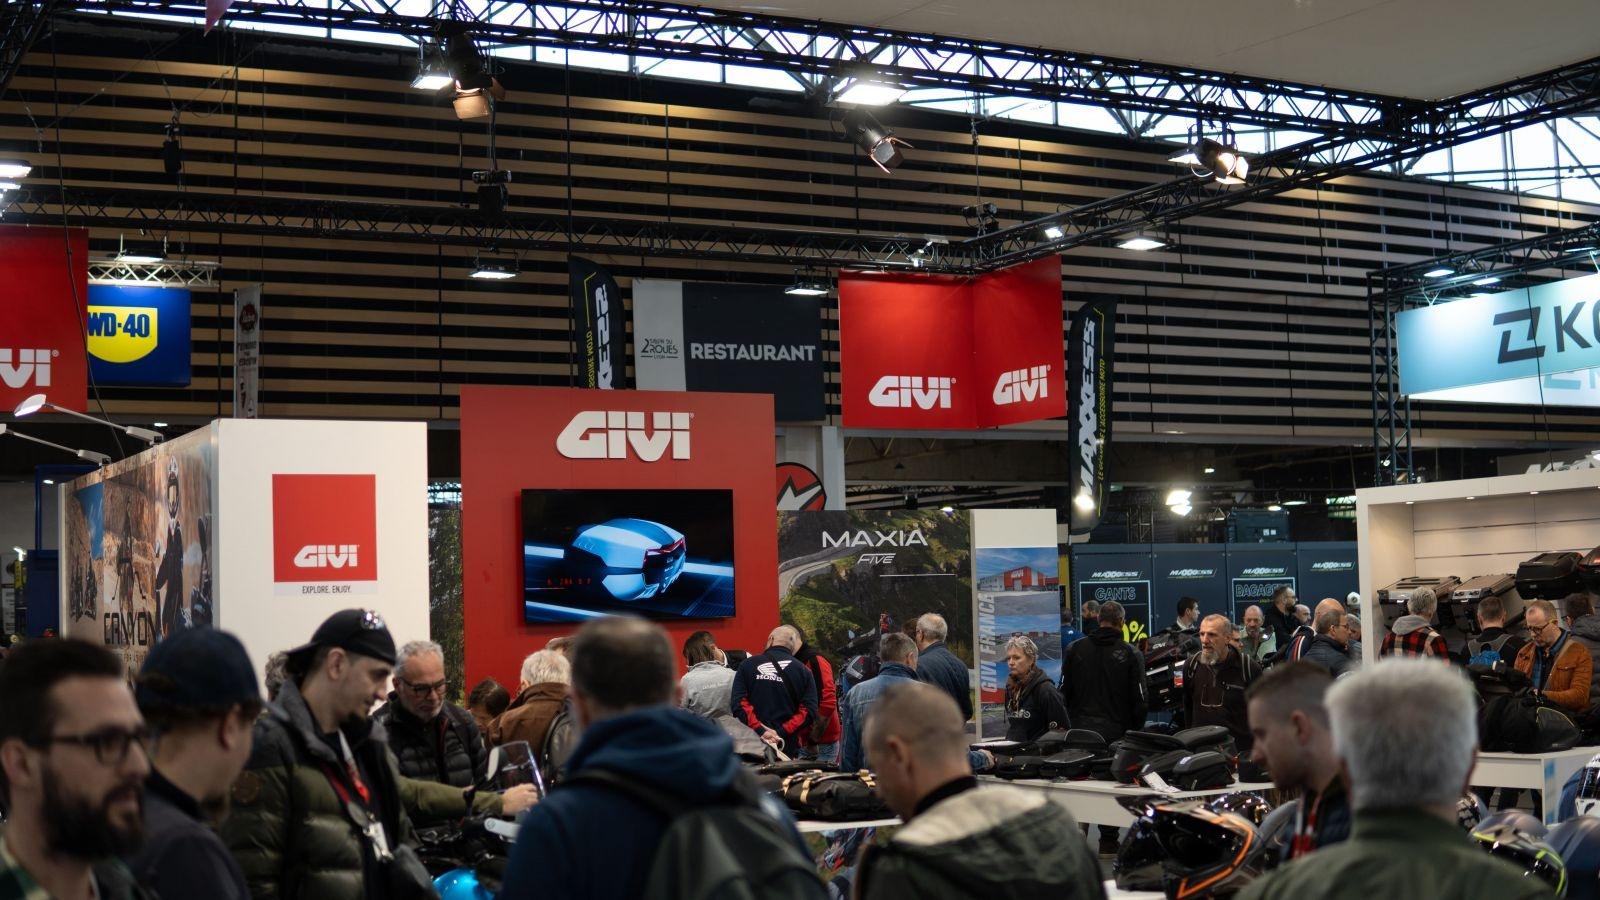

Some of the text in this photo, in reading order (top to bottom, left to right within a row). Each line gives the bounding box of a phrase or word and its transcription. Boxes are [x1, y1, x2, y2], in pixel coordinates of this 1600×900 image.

[88, 312, 150, 338] WD-40
[1554, 298, 1600, 353] K
[641, 338, 678, 354] 2 ROUES
[690, 342, 816, 362] RESTAURANT
[868, 375, 954, 410] GIVI
[992, 365, 1049, 406] GIVI
[556, 410, 691, 462] GIVI
[822, 529, 929, 548] MAXIA
[293, 544, 358, 569] GIVI
[856, 552, 897, 565] FIVE
[302, 585, 351, 594] EXPLORE. ENJOY.
[1094, 587, 1136, 601] GANTS
[1235, 584, 1284, 597] BAGAG
[756, 674, 784, 683] HOND
[980, 661, 998, 693] GIVI
